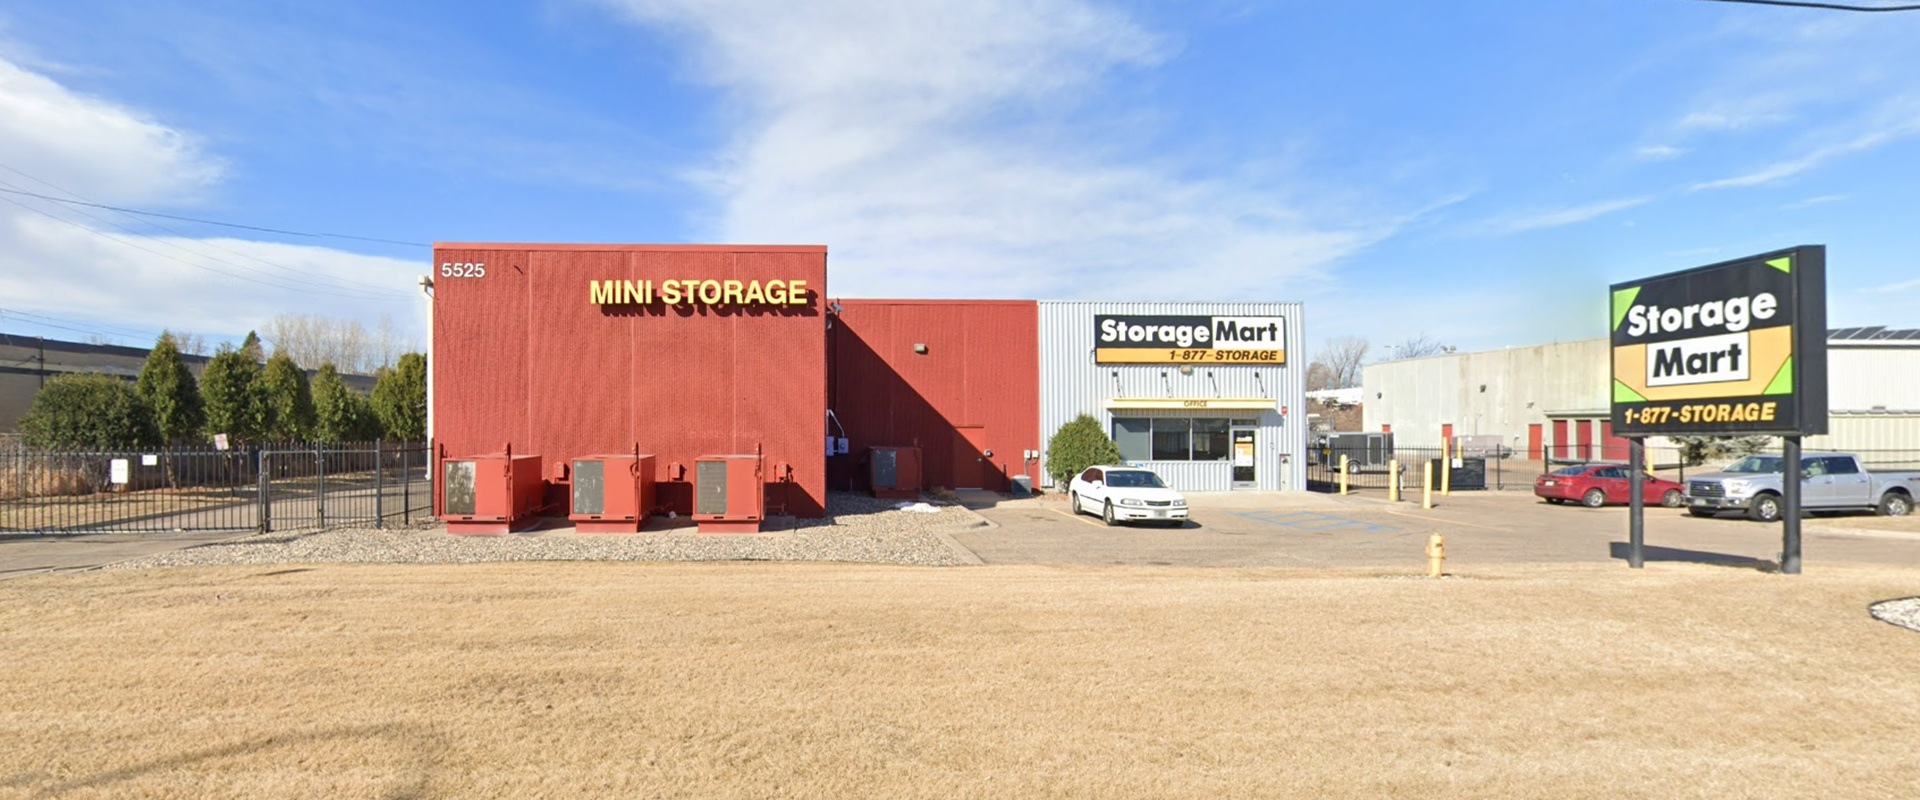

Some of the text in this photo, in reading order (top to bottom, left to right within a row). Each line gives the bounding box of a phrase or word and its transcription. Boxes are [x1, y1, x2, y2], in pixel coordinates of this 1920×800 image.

[441, 263, 486, 278] 5525
[590, 279, 808, 305] MINI STORAGE
[1627, 292, 1777, 337] Storage
[1101, 319, 1278, 347] Storage Mart
[1652, 343, 1742, 378] Mart
[1184, 400, 1208, 408] OFFICE
[1624, 402, 1777, 424] 1-877-STORAGE
